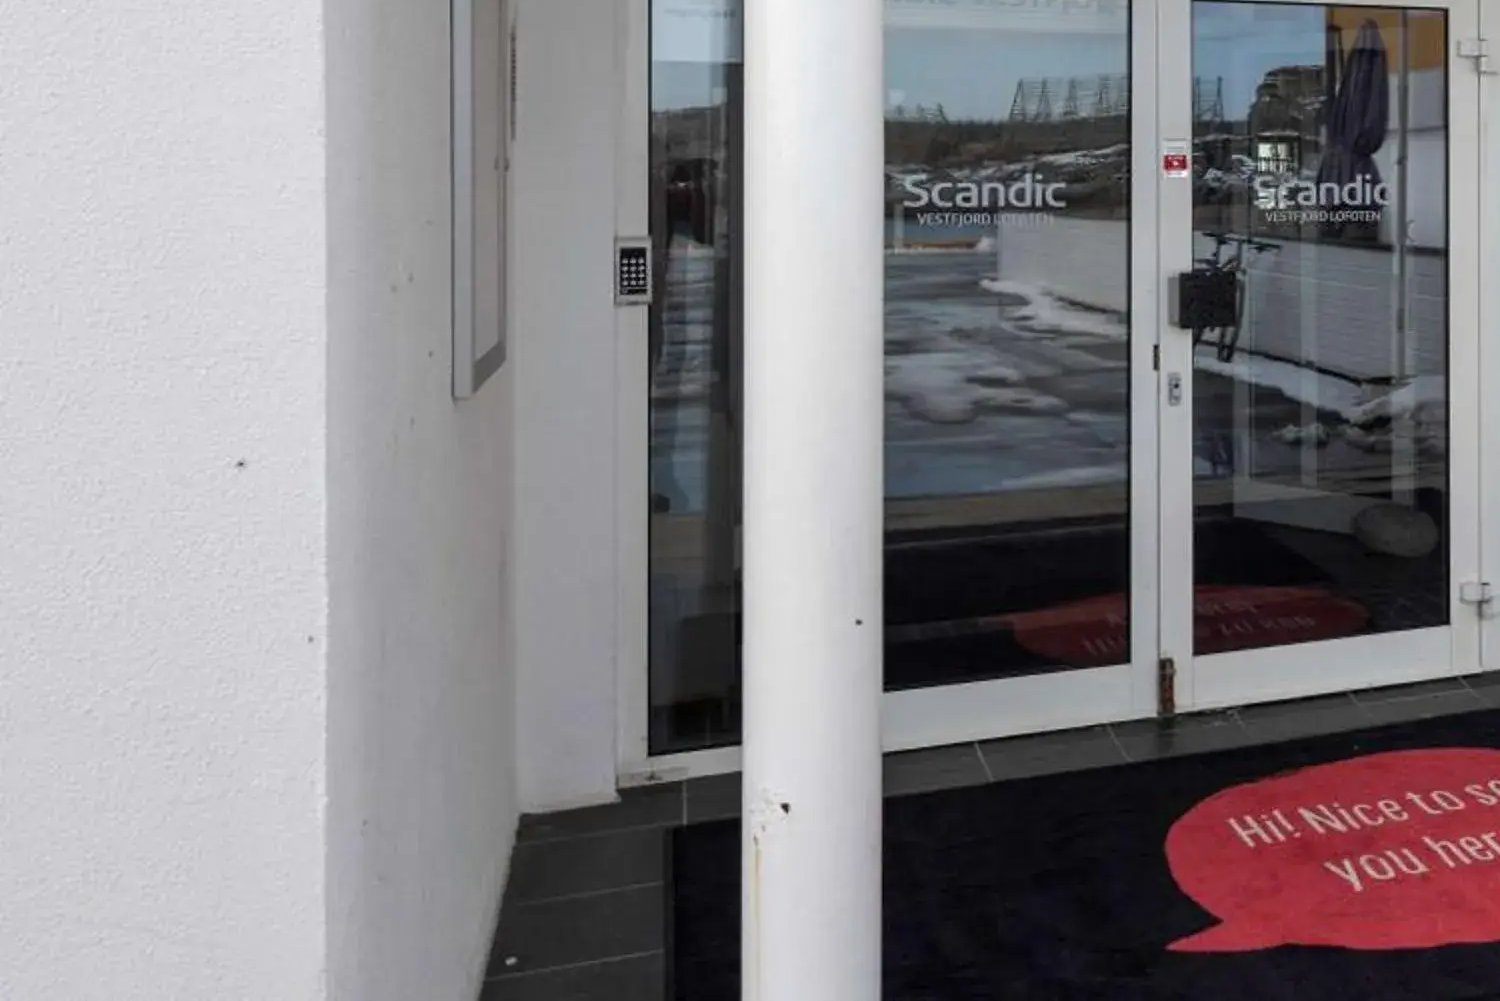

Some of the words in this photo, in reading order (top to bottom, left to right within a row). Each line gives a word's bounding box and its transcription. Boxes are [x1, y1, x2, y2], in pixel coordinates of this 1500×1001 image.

[903, 172, 1067, 208] Scandic
[1253, 173, 1390, 209] Scandic
[916, 211, 991, 228] VESTFJORD
[1225, 809, 1302, 848] Hi!
[1297, 798, 1409, 836] Nice
[1406, 790, 1466, 815] to
[1323, 847, 1430, 892] you
